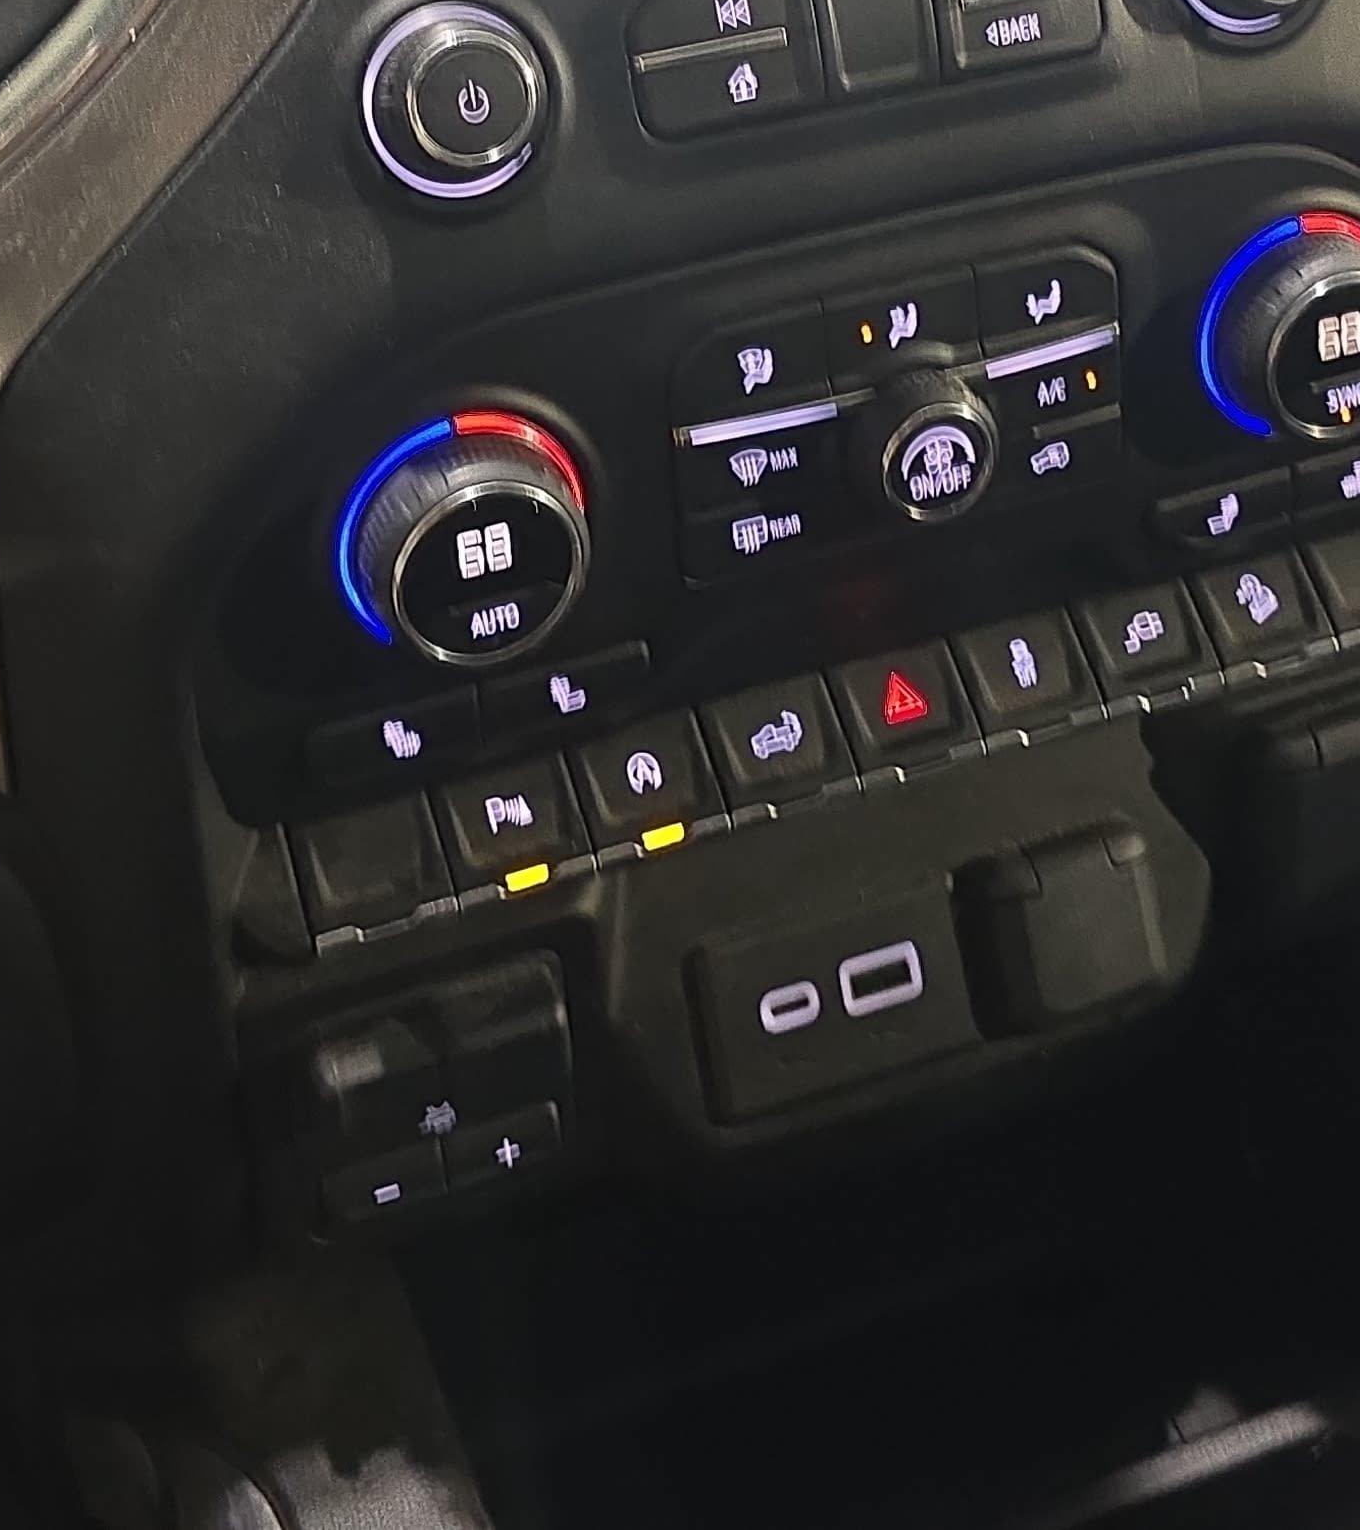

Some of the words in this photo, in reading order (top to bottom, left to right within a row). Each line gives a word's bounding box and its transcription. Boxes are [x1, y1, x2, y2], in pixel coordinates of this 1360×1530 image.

[998, 13, 1041, 46] BACK
[1037, 376, 1066, 407] A/C
[769, 447, 798, 472] MAX
[909, 463, 972, 502] ON/OFF
[769, 514, 801, 541] REAR
[471, 602, 520, 639] AUTO
